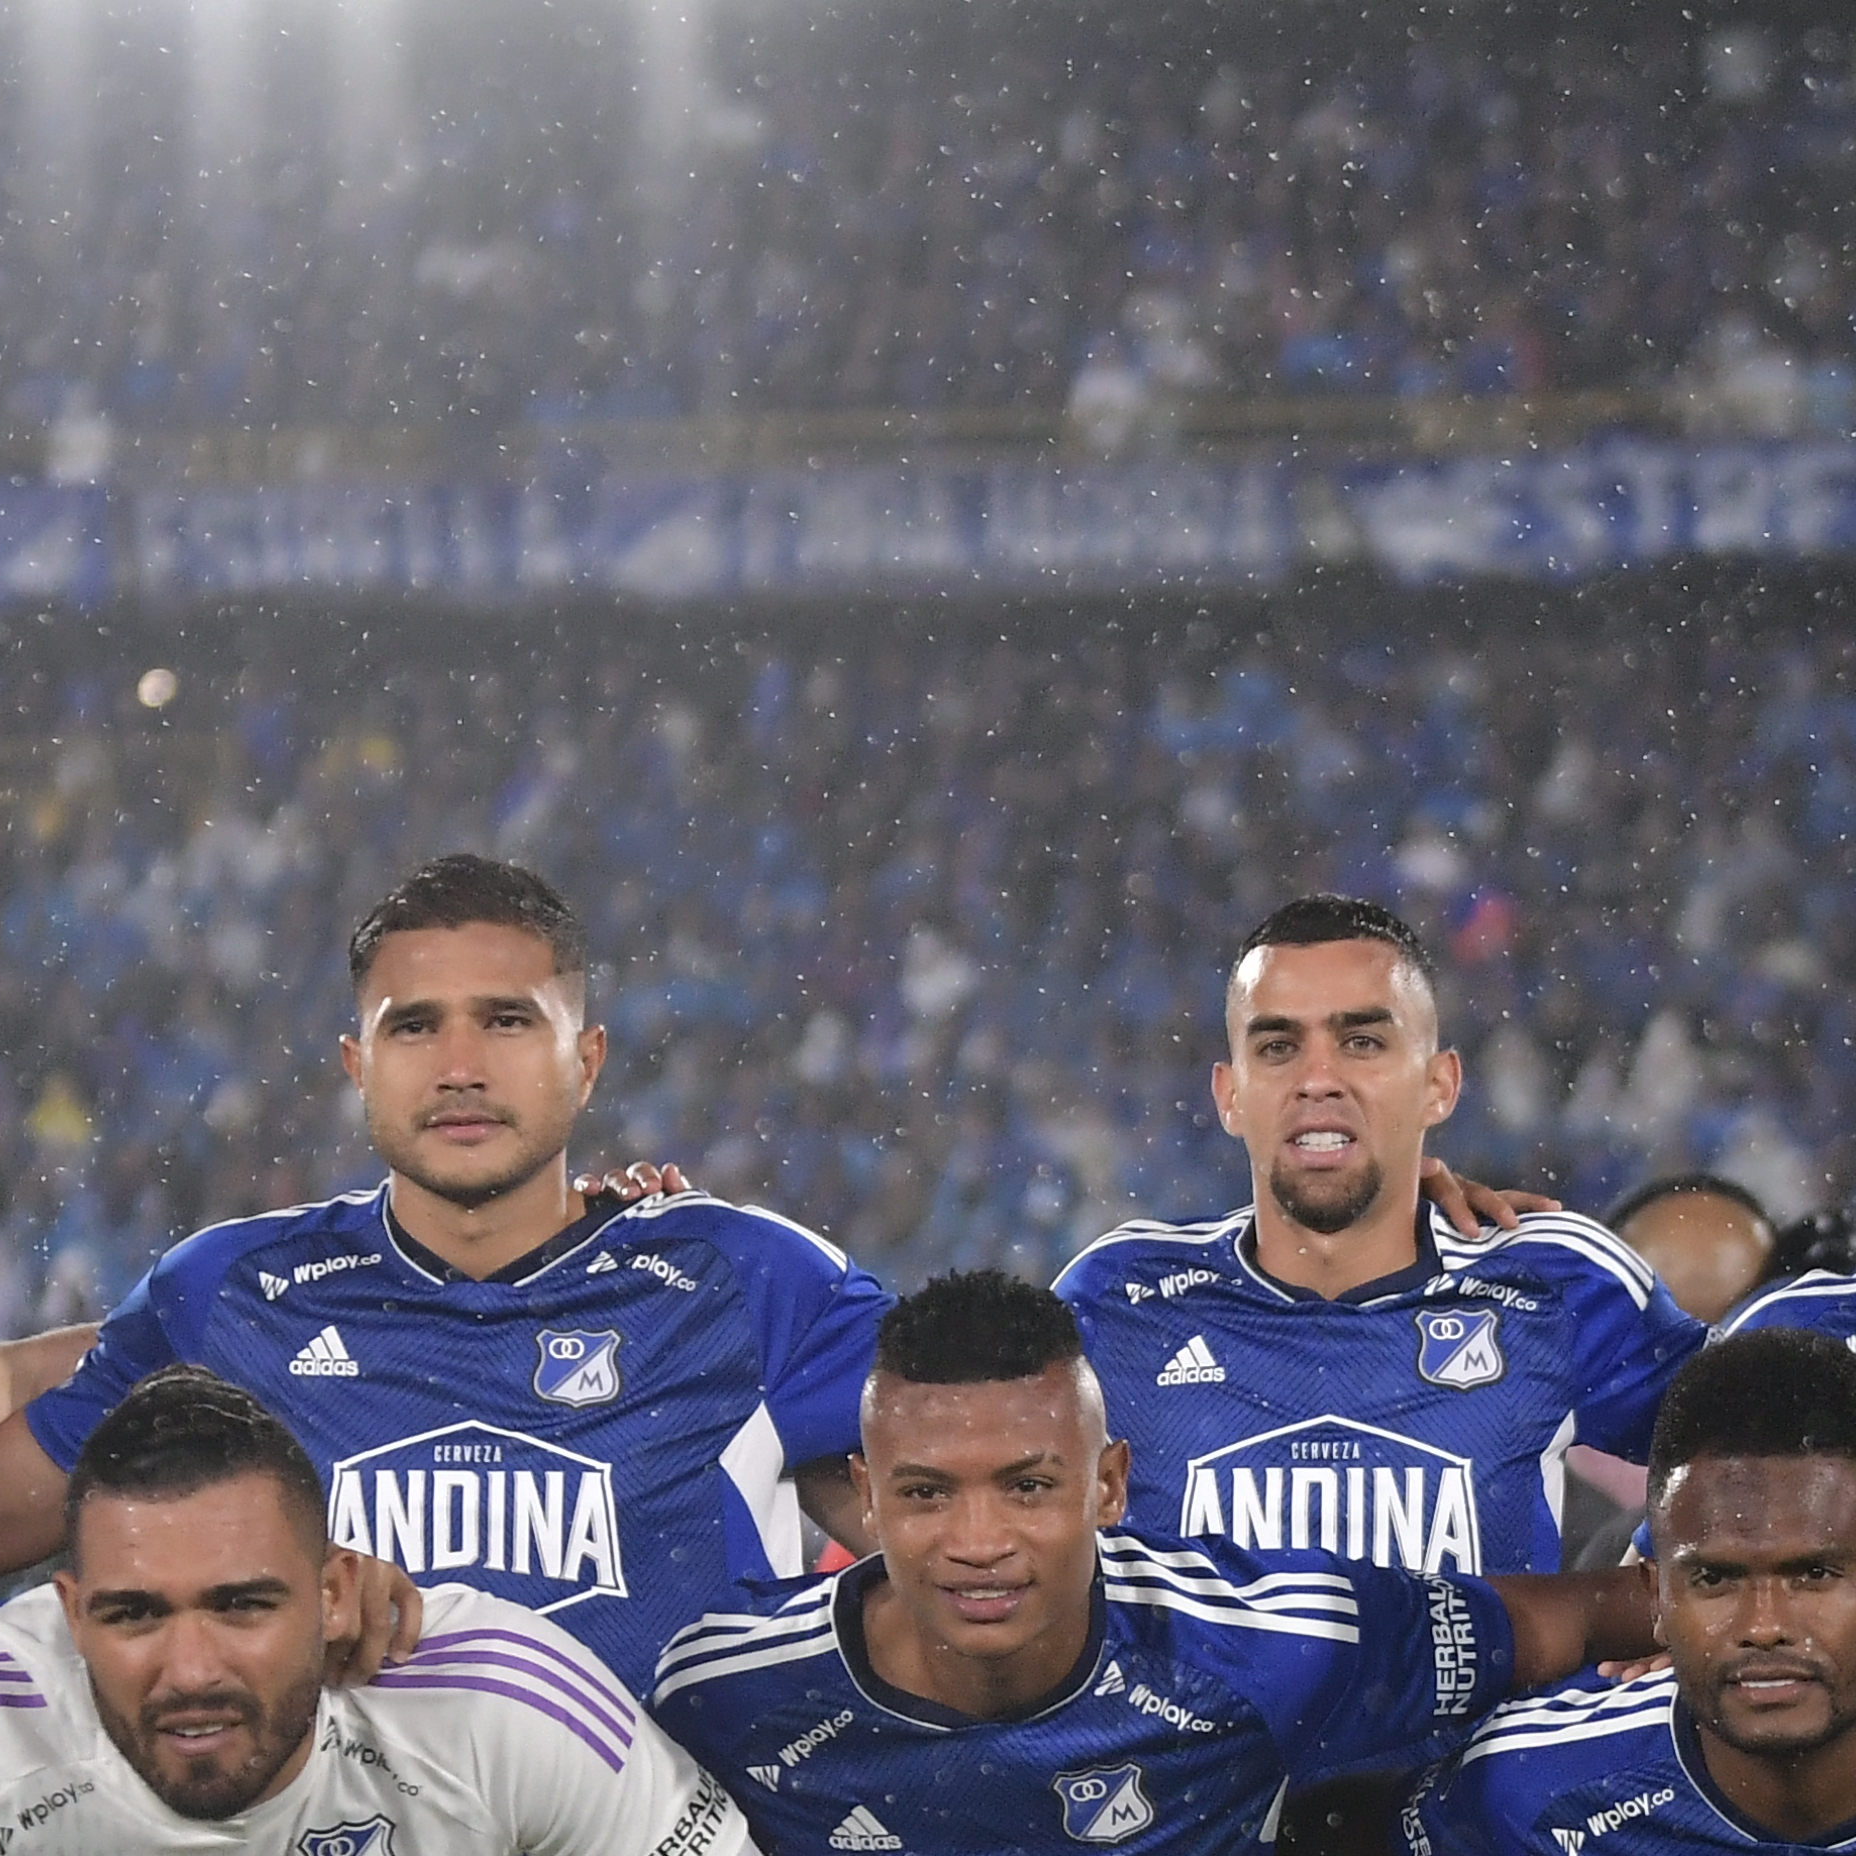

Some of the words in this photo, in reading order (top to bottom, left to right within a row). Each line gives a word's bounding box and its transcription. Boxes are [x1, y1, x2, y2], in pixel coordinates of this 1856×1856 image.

[293, 1252, 382, 1285] Wplay.co
[289, 1358, 359, 1377] adidas
[1156, 1365, 1226, 1387] adidas
[433, 1444, 503, 1464] CERVEZA
[1291, 1441, 1361, 1461] CERVEZA
[1127, 1683, 1214, 1734] Wplay.co
[778, 1709, 855, 1768] Wplay.co
[17, 1779, 95, 1831] Wplay.co
[1587, 1787, 1674, 1837] Wplay.co
[828, 1833, 903, 1852] adidas
